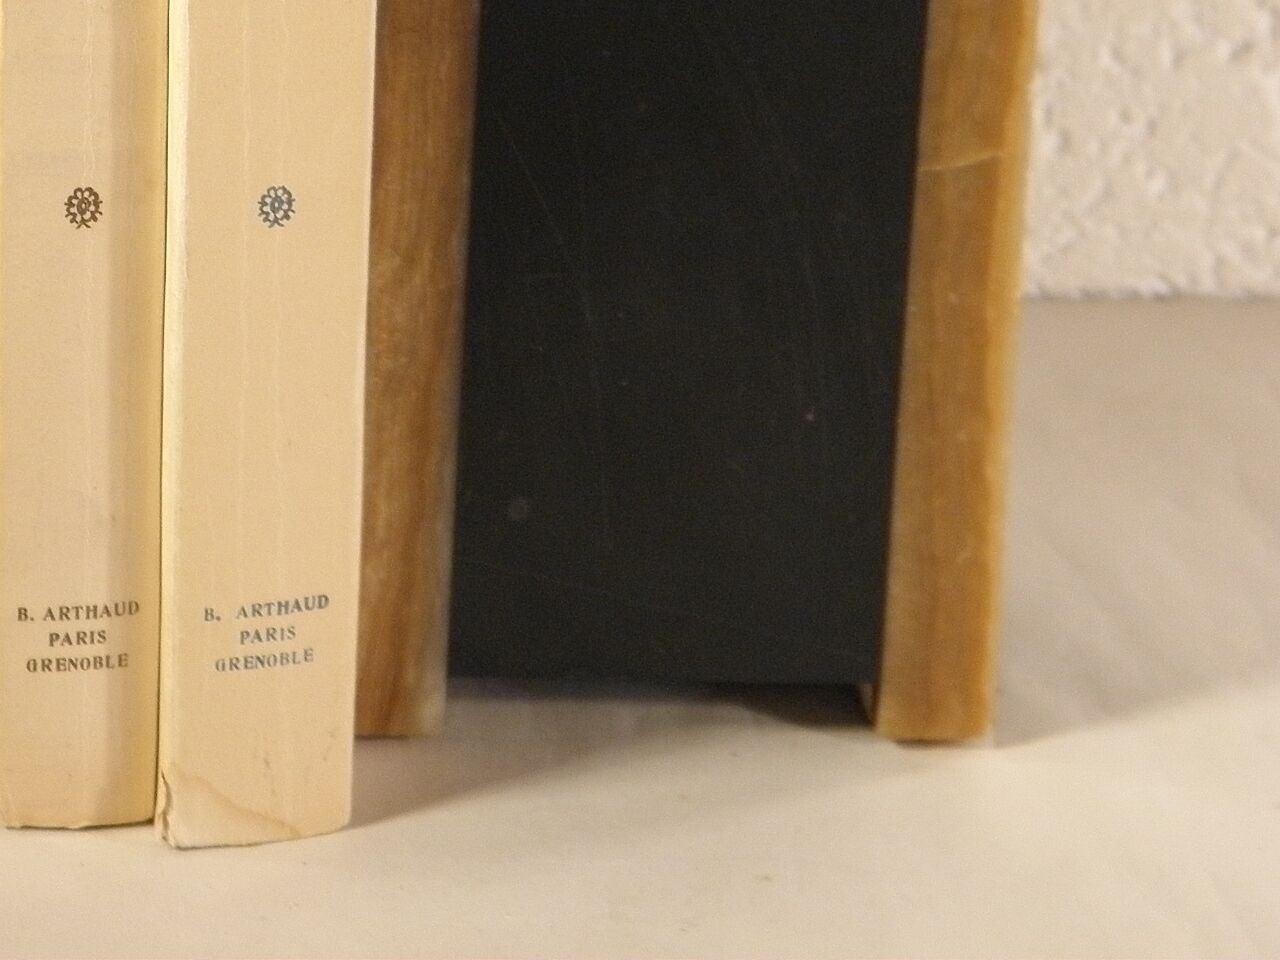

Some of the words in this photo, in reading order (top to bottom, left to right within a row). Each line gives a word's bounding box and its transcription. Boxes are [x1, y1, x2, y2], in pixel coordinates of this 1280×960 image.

[18, 607, 34, 621] B.
[43, 601, 140, 621] ARTHAUD
[204, 608, 221, 622] B.
[236, 594, 329, 619] ARTHAUD
[49, 630, 106, 647] PARIS
[240, 625, 296, 645] PARIS
[26, 653, 128, 673] GRENOBLE
[215, 648, 313, 672] GRENOBLE
